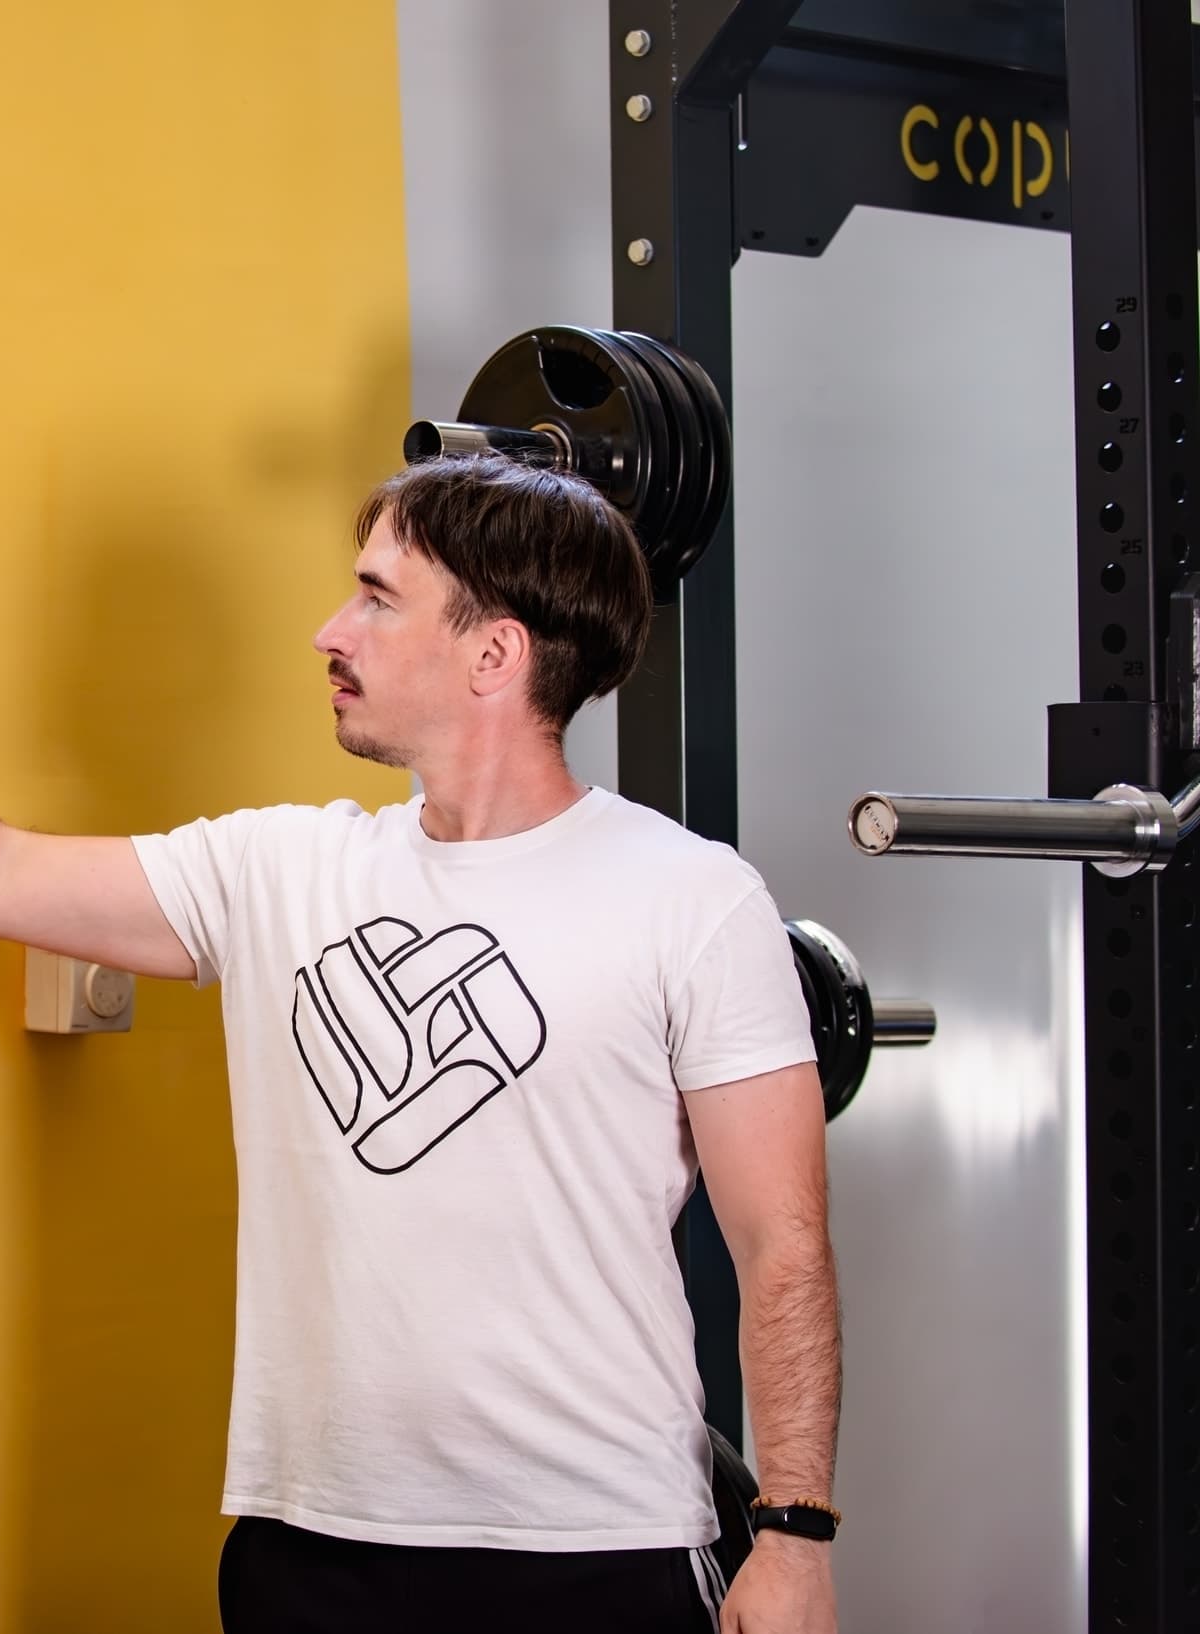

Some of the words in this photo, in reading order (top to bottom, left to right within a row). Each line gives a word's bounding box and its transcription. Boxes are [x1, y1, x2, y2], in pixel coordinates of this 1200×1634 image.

[901, 104, 1071, 208] cop
[1115, 297, 1137, 313] 29
[1119, 418, 1139, 433] 27
[1121, 539, 1142, 555] 25
[1123, 660, 1144, 677] 23
